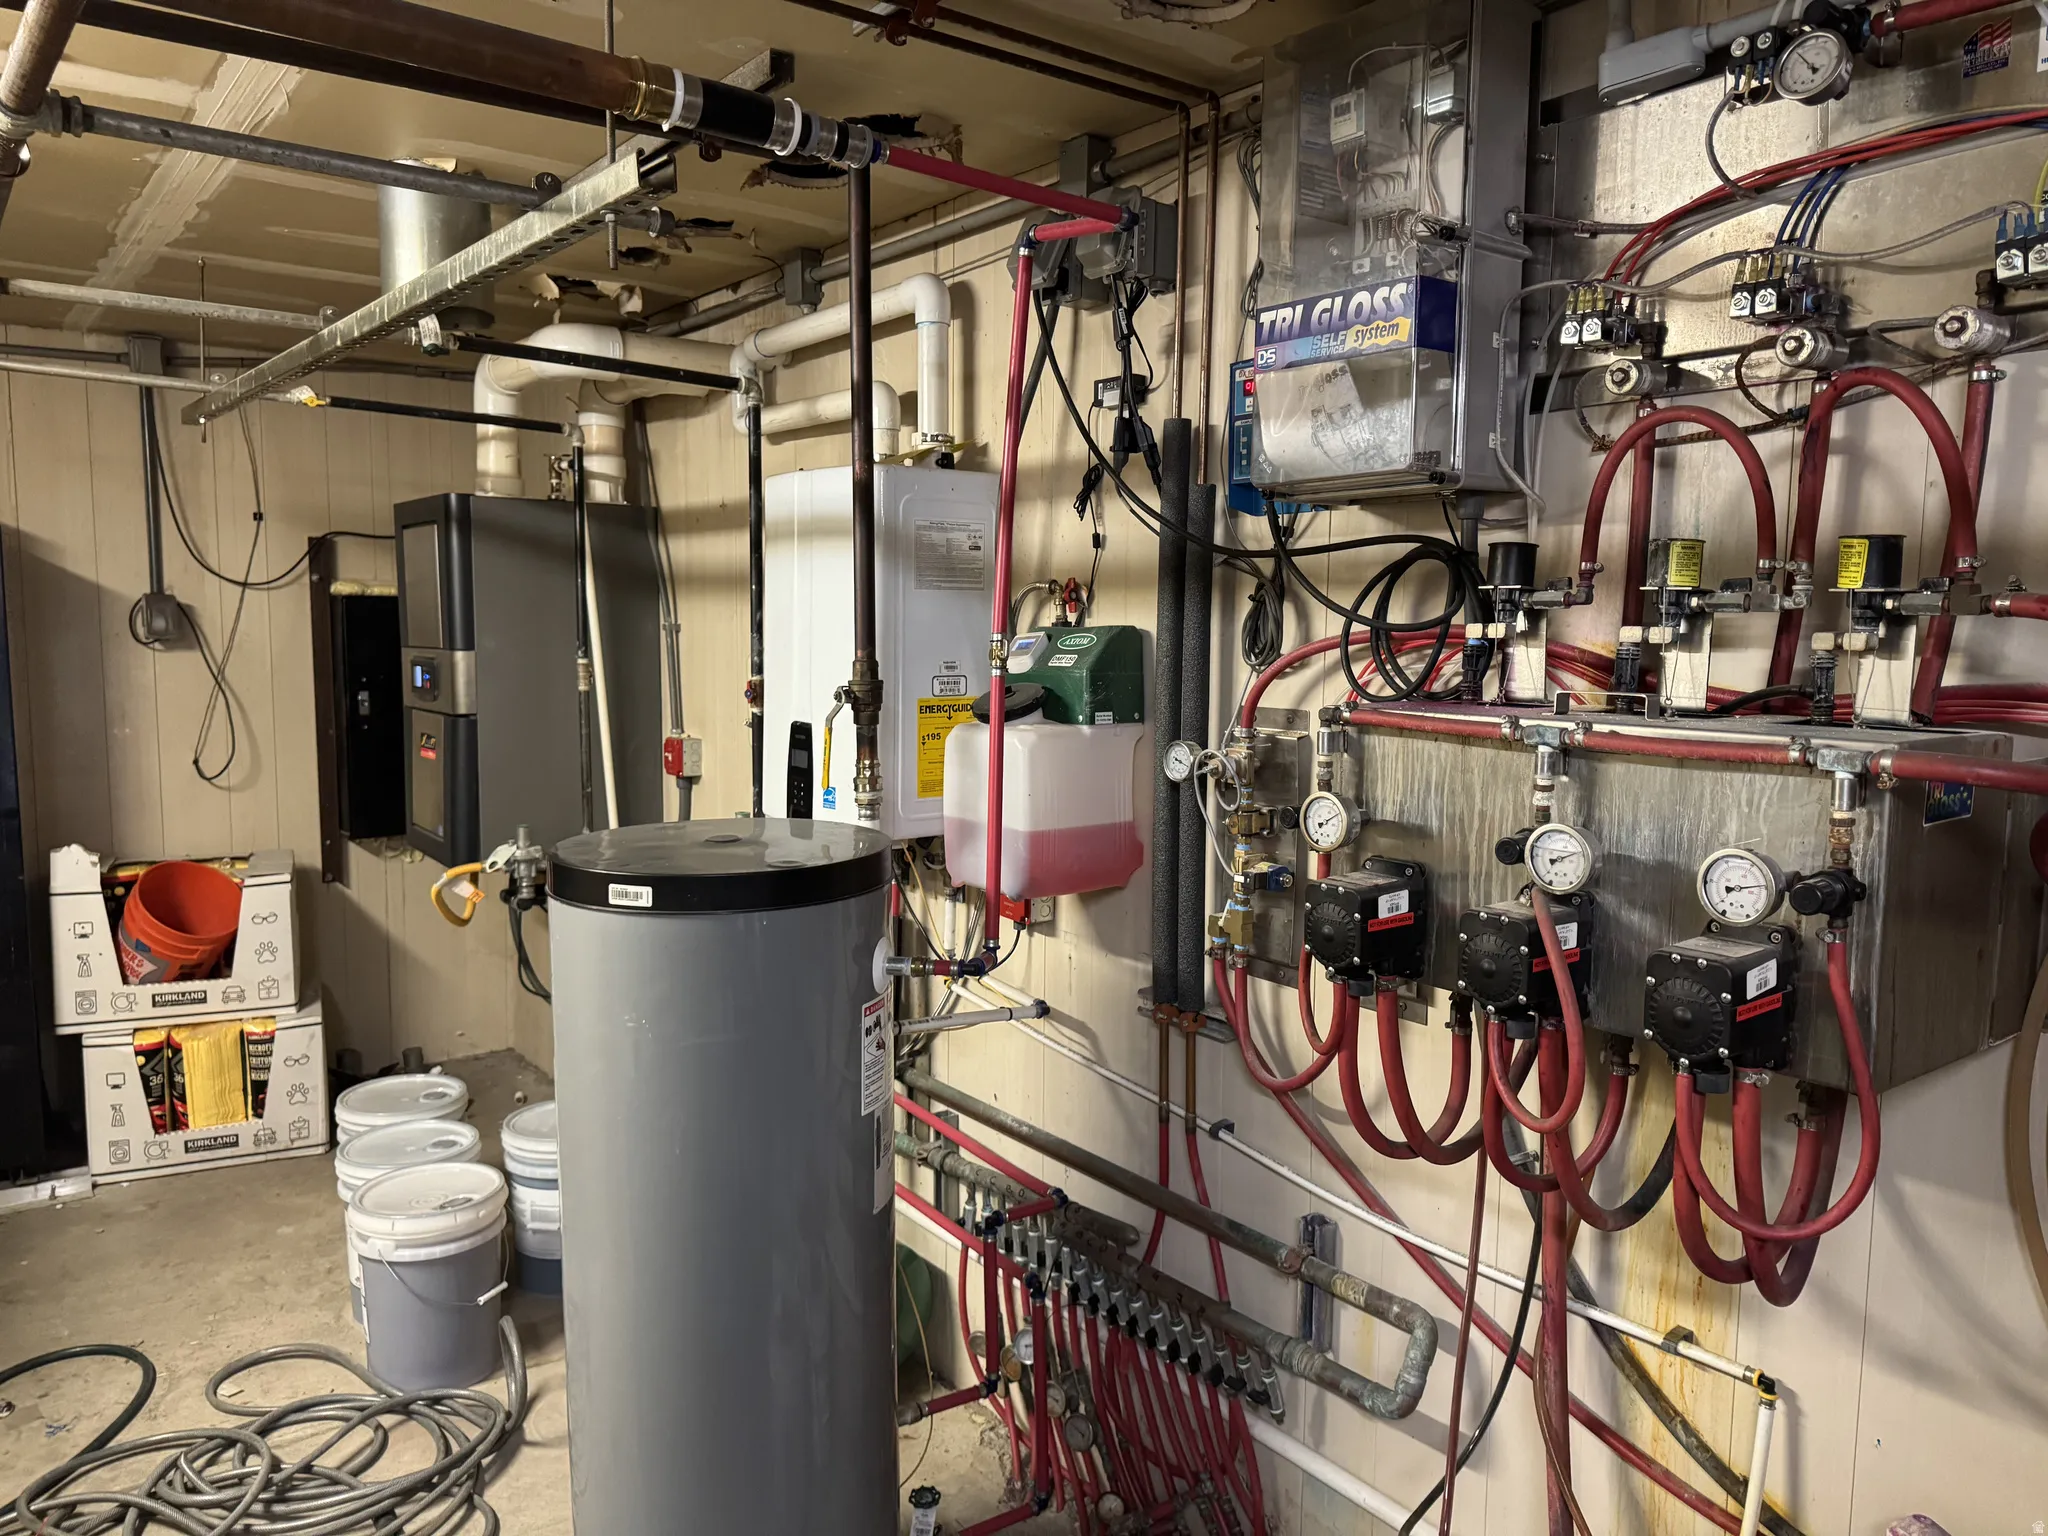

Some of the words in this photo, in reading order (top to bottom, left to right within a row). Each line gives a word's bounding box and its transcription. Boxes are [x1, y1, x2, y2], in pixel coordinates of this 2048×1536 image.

[1259, 304, 1304, 346] TRI
[1310, 282, 1408, 336] GLOSS
[1311, 331, 1347, 350] SELF
[1353, 321, 1400, 347] system
[1257, 348, 1277, 365] DS
[1310, 344, 1345, 358] SERVICE
[1063, 637, 1091, 645] AXIOM
[919, 703, 973, 716] ENERGYGUID
[922, 732, 942, 741] $195
[154, 991, 206, 1002] KIRKLAND
[149, 1073, 164, 1086] 36
[173, 1072, 184, 1083] 36
[187, 1135, 237, 1148] KIRKLAND
